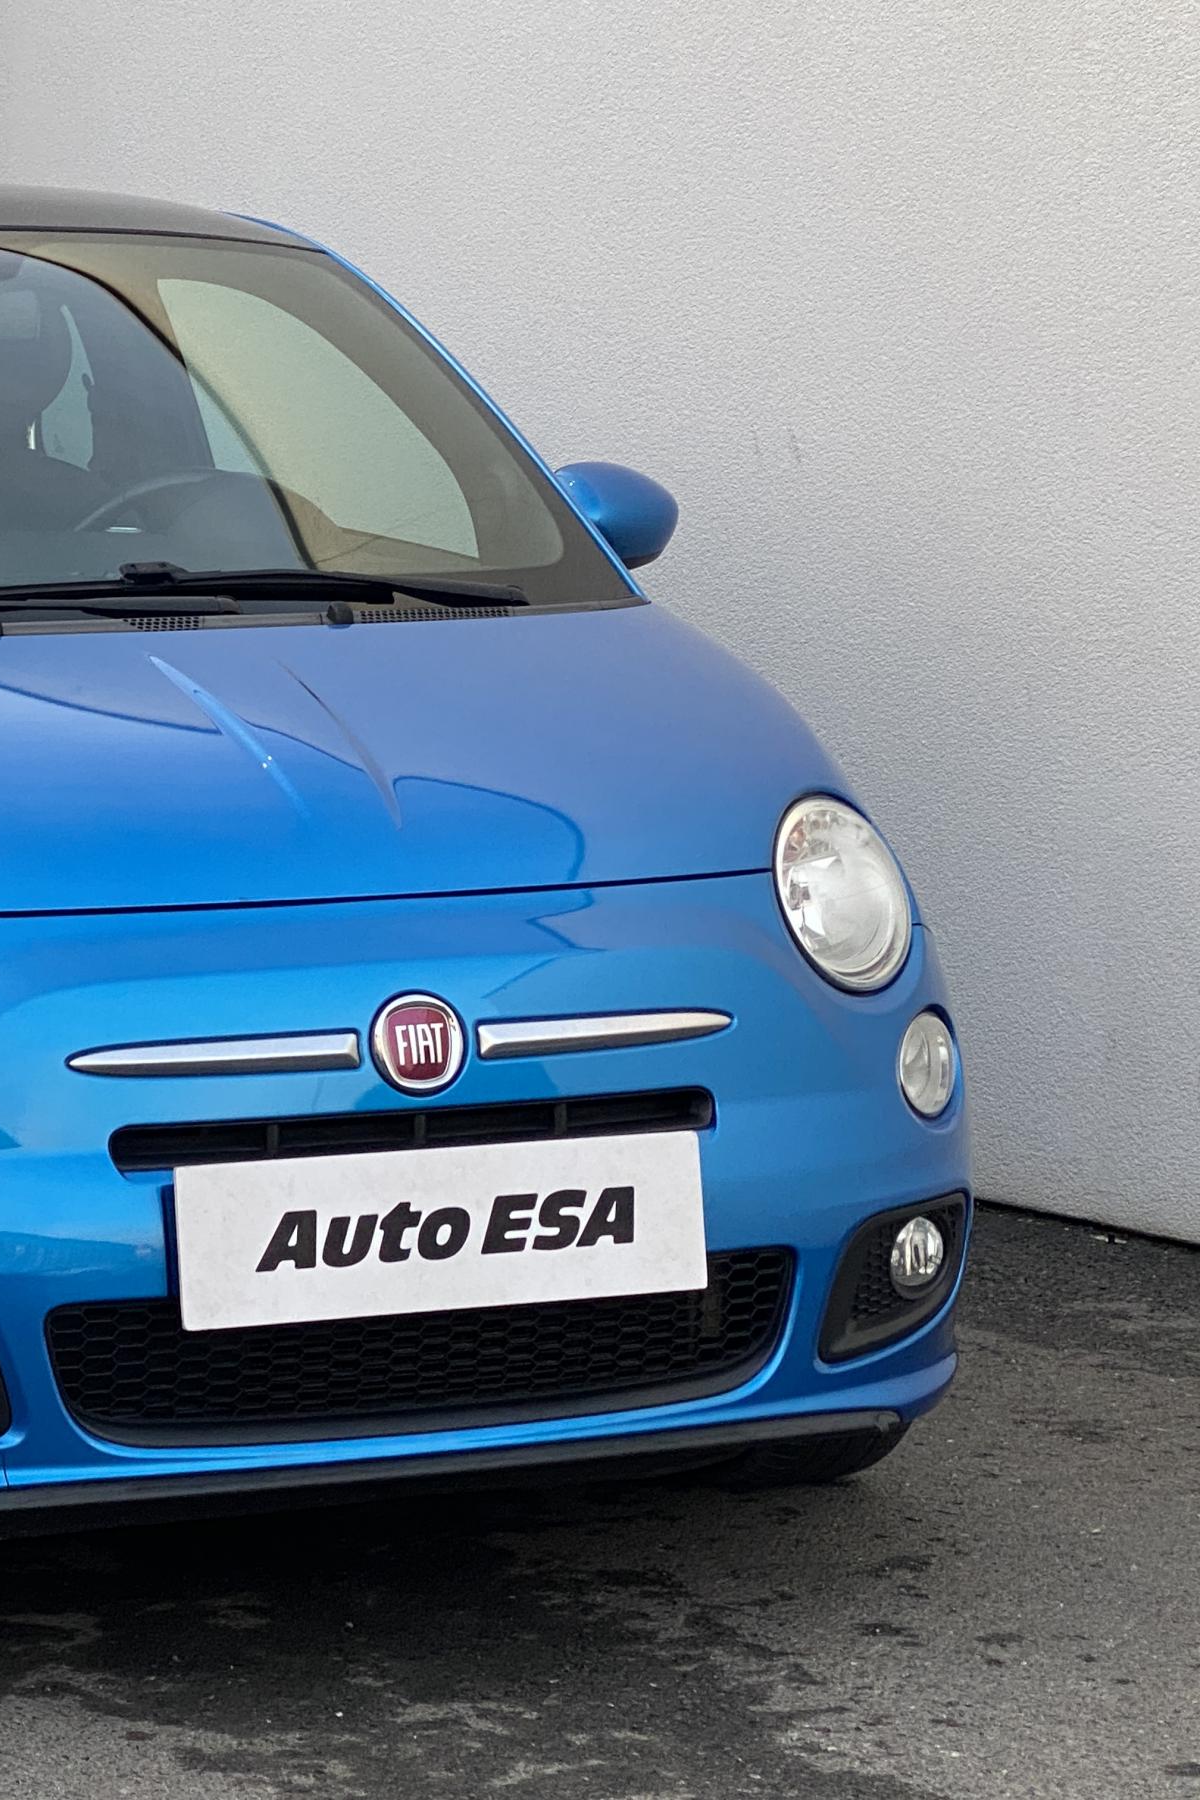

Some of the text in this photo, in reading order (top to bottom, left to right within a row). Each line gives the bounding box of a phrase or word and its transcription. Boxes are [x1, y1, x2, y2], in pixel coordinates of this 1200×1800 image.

[394, 1022, 444, 1066] FIAT
[255, 1185, 635, 1273] Auto ESA
